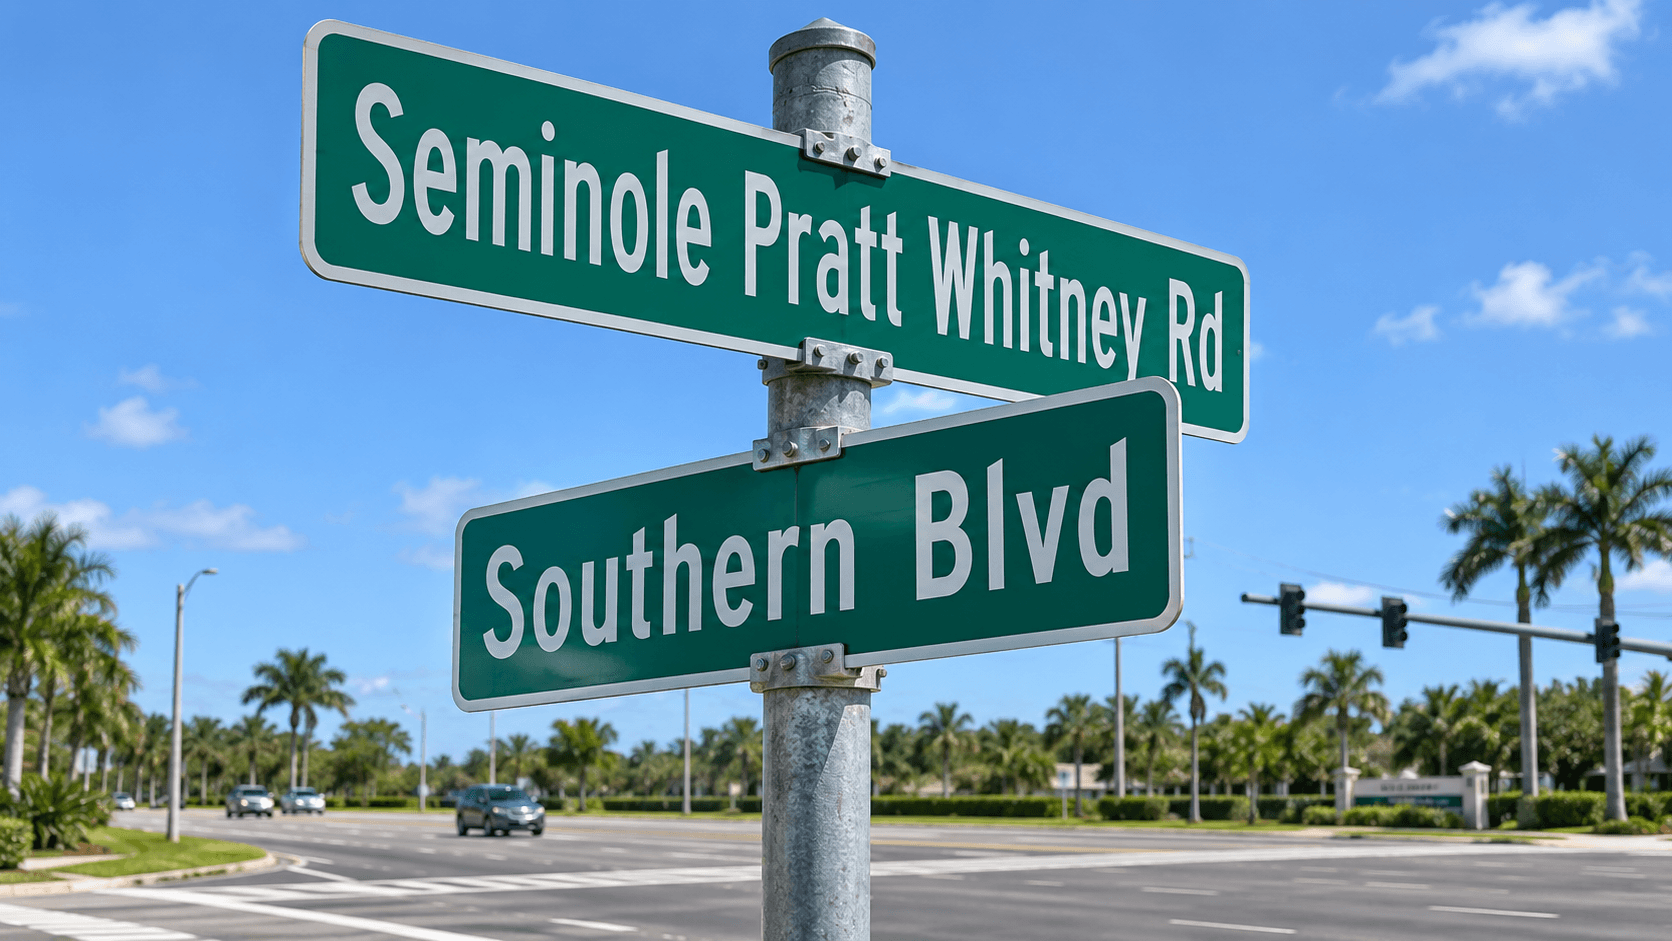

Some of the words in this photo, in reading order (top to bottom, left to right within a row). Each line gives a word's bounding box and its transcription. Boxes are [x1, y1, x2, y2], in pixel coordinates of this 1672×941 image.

[352, 83, 711, 286] Seminole
[744, 171, 903, 327] Pratt
[928, 215, 1147, 381] Whitney
[1168, 277, 1223, 393] Rd
[483, 513, 856, 660] Southern
[915, 437, 1129, 601] Blvd
